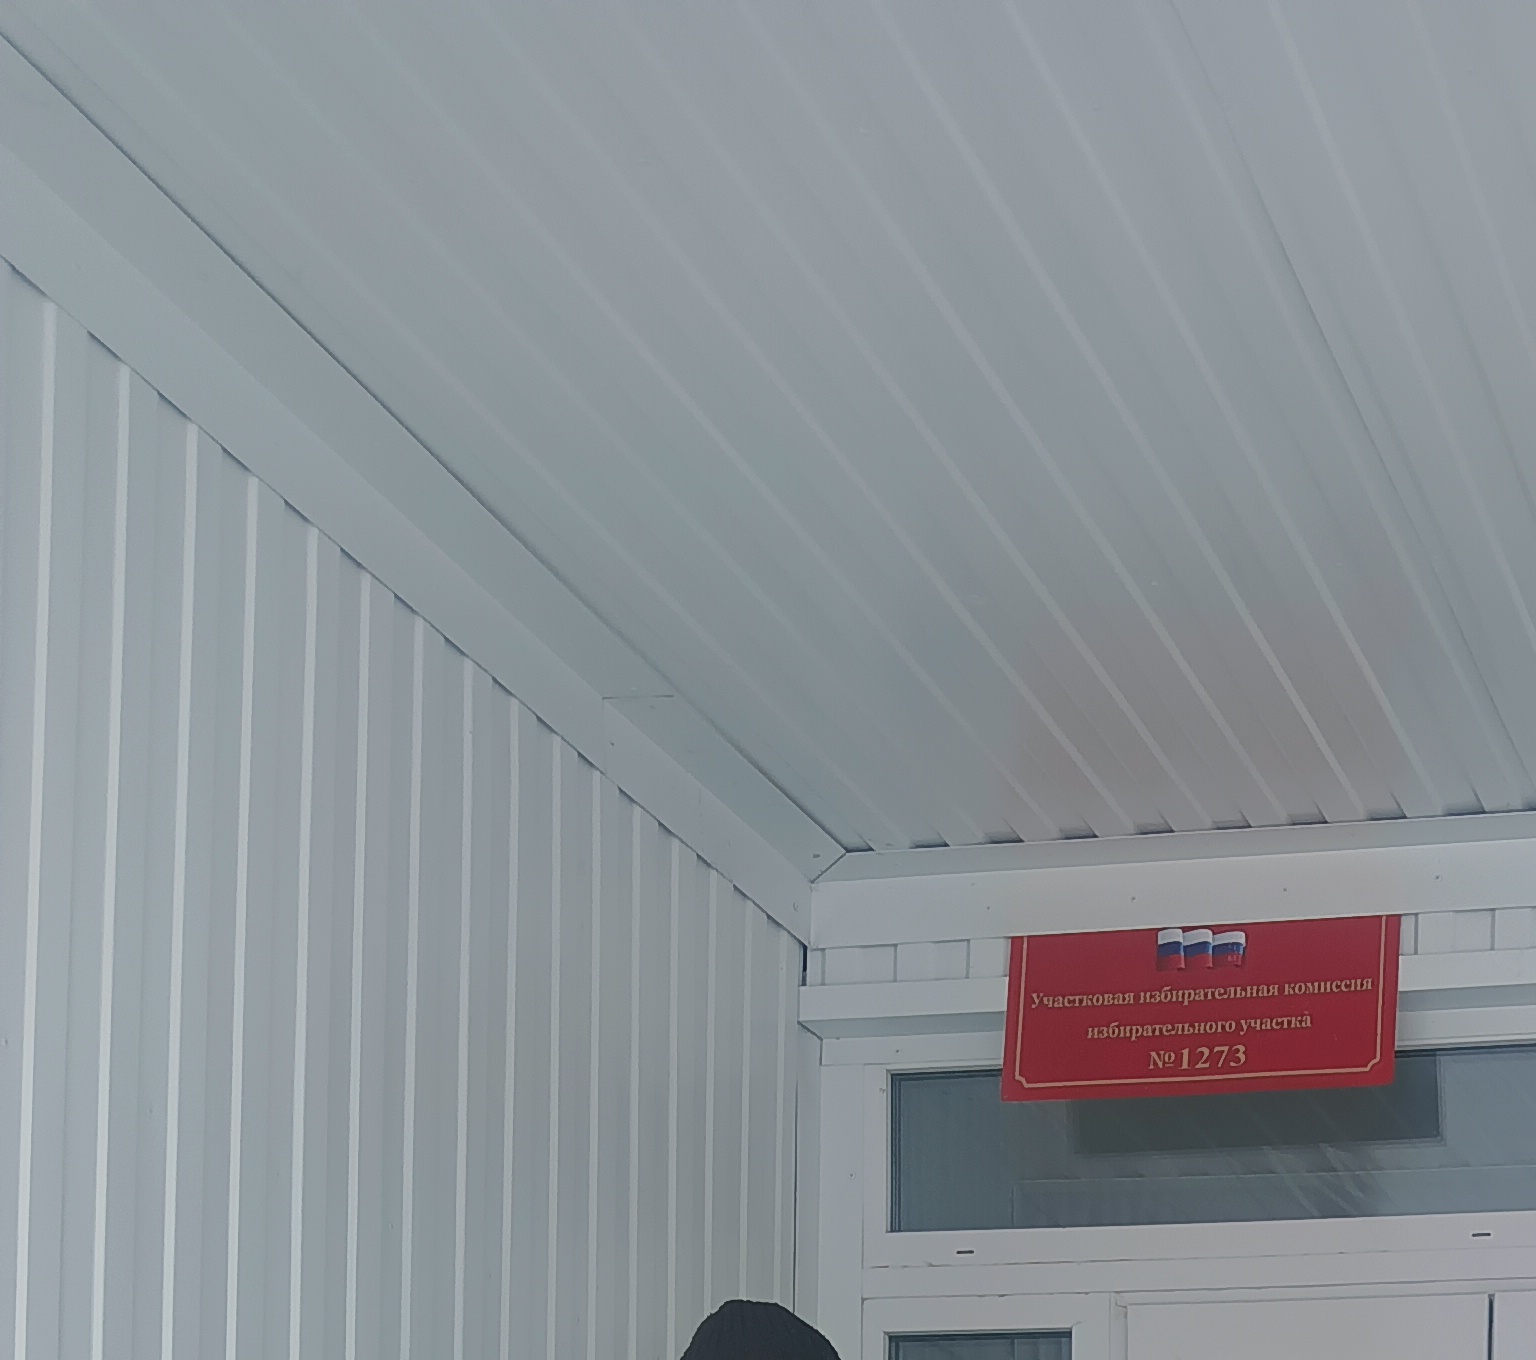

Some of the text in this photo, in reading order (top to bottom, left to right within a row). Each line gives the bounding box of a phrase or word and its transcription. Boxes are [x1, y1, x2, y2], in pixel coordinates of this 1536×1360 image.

[1030, 975, 1374, 1010] Участковая избирательная комиссия
[1086, 1012, 1312, 1042] избирательного участка
